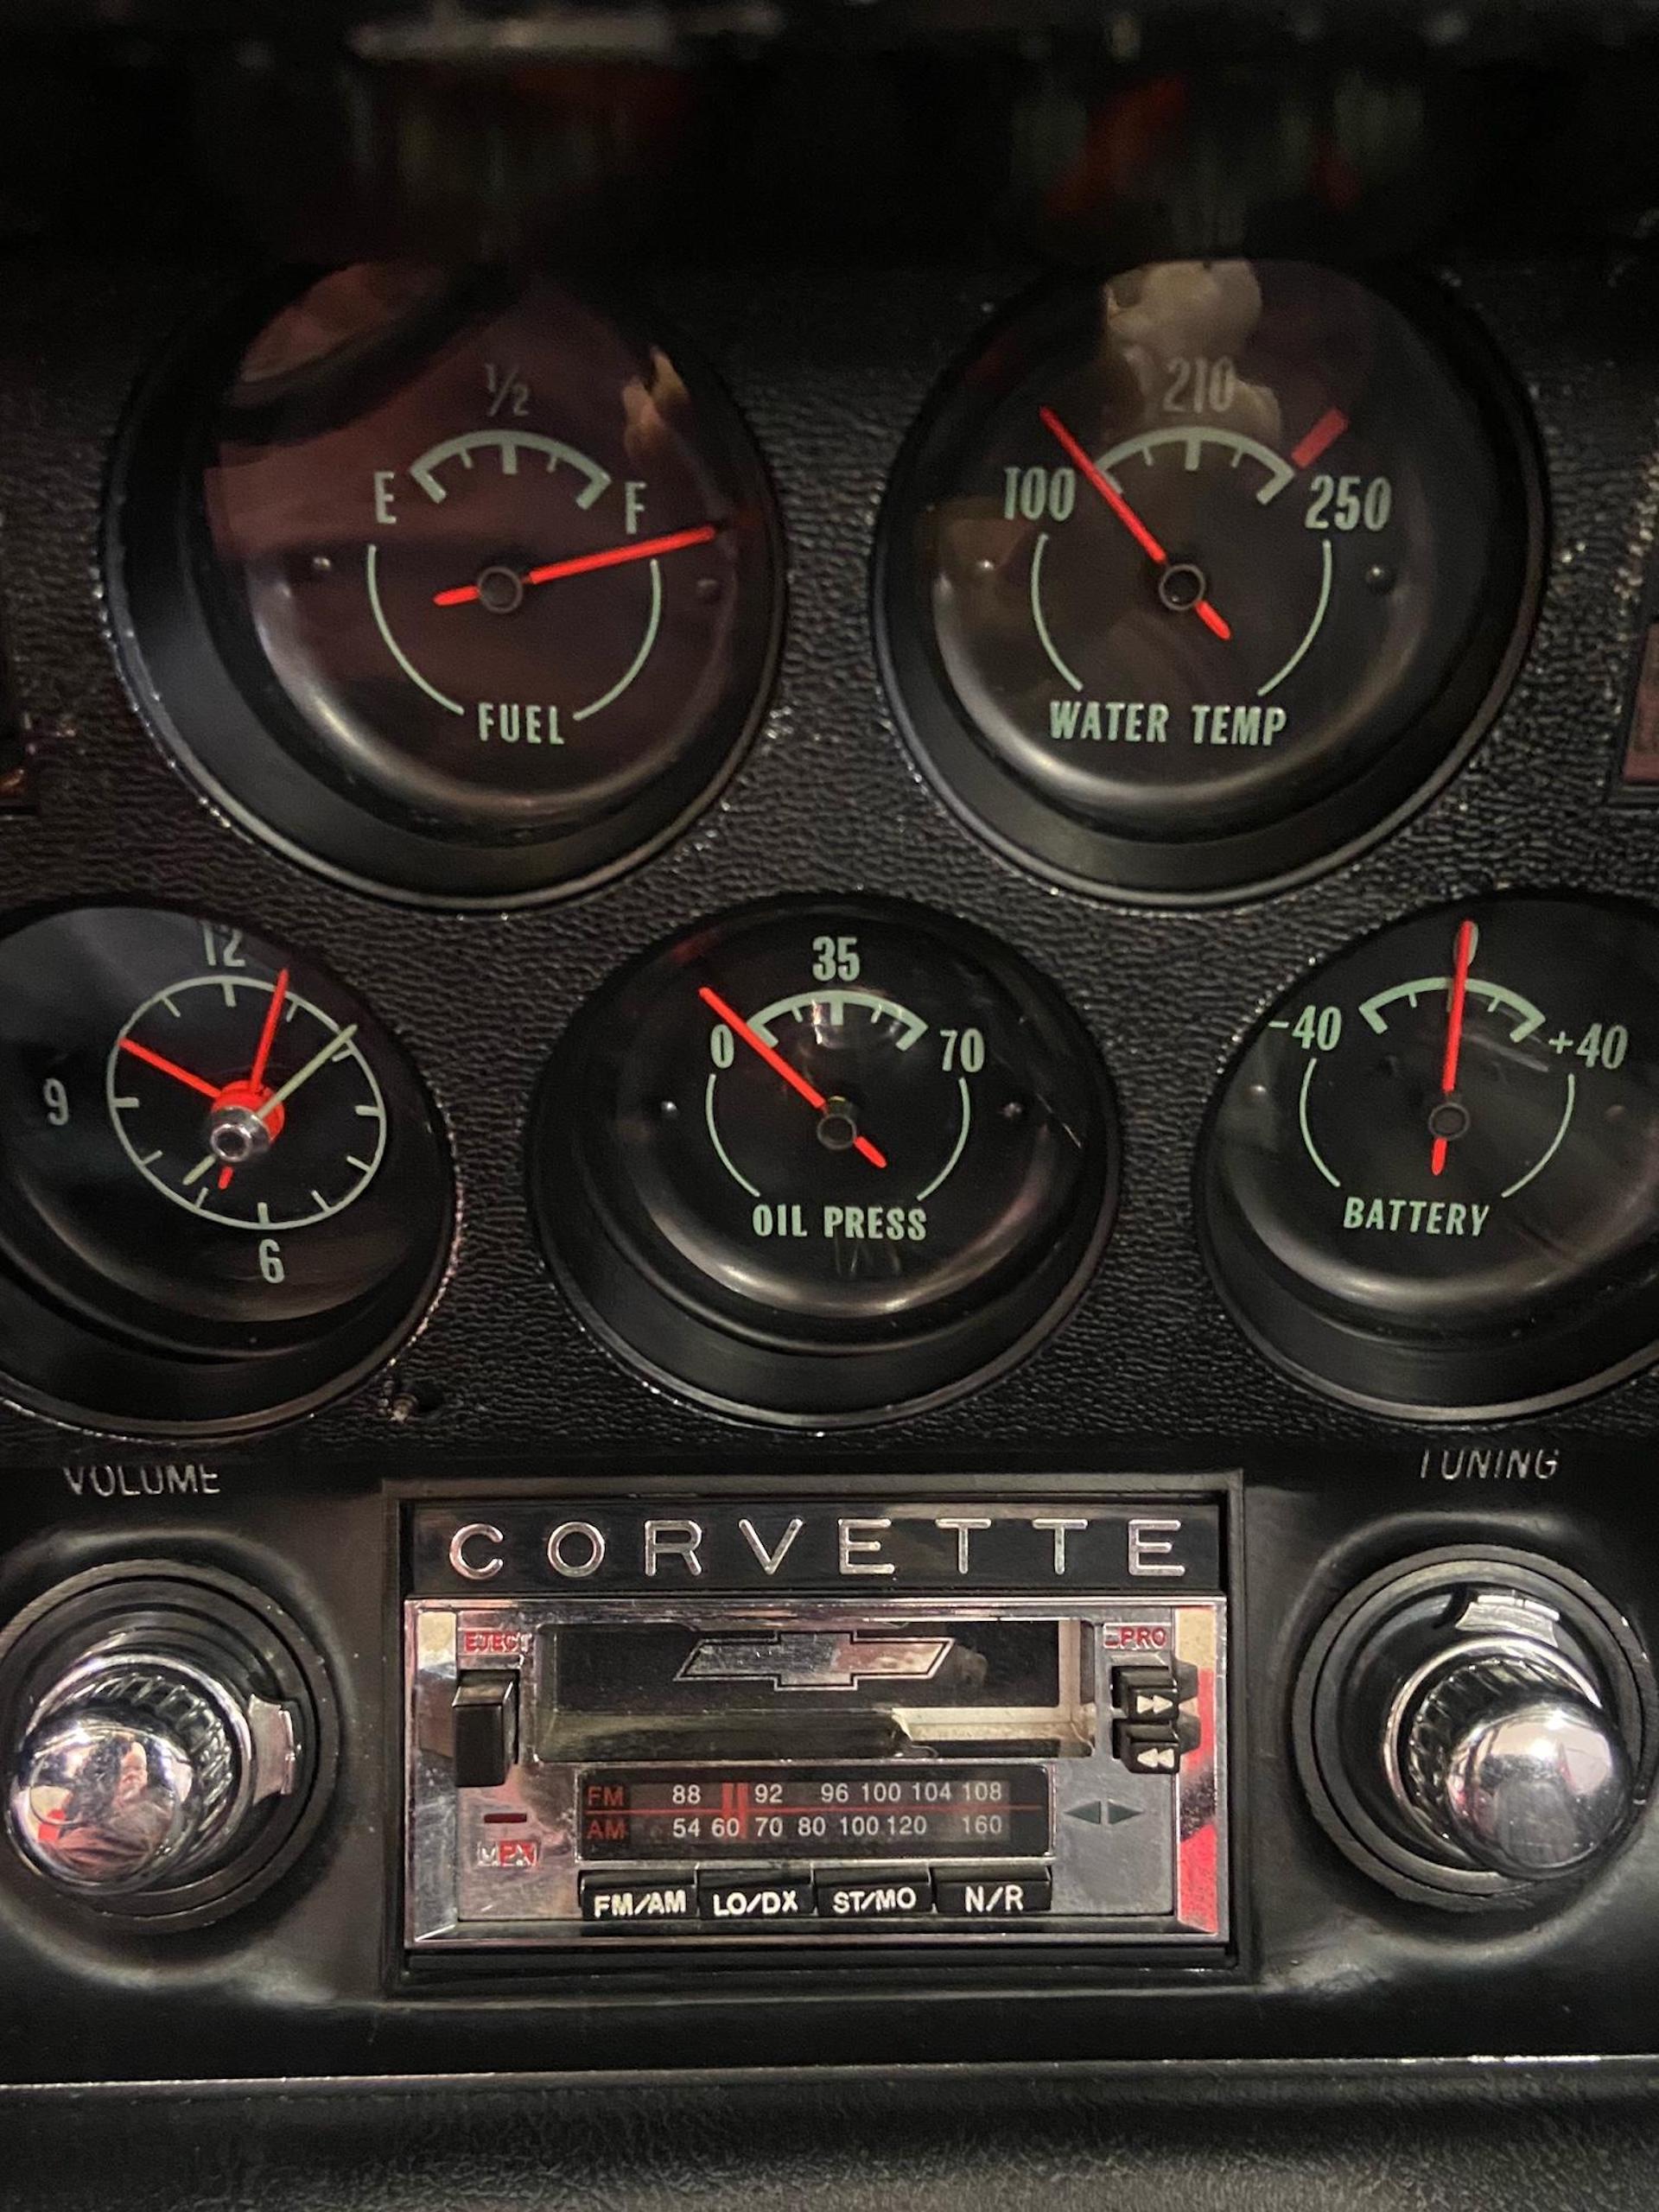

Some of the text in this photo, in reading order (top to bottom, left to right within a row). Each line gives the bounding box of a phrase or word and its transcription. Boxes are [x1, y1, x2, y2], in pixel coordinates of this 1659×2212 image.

[1162, 357, 1236, 413] 210
[373, 472, 397, 524] E
[626, 481, 647, 535] F
[1002, 466, 1077, 521] 100
[1304, 474, 1393, 531] 250
[478, 702, 564, 745] FUEL
[1049, 701, 1287, 746] WATER TEMP
[812, 936, 861, 982] 35
[710, 1024, 735, 1069] 0
[939, 1027, 986, 1073] 70
[1268, 1005, 1342, 1051] -40
[1548, 1023, 1630, 1070] +40
[43, 1078, 69, 1125] 9
[753, 1204, 927, 1241] OIL PRESS
[1343, 1197, 1491, 1236] BATTERY
[260, 1239, 285, 1284] 6
[64, 1464, 222, 1497] VOLUME
[448, 1517, 1186, 1581] CORVETTE
[587, 1781, 1002, 1807] FM 88 92 96 100 104 108
[587, 1815, 1002, 1840] AM 54 60 70 80 100 120 160
[594, 1889, 687, 1917] FM/AM
[713, 1889, 799, 1916] LO/DX
[832, 1886, 917, 1915] ST/MO
[964, 1884, 1025, 1913] N/R
